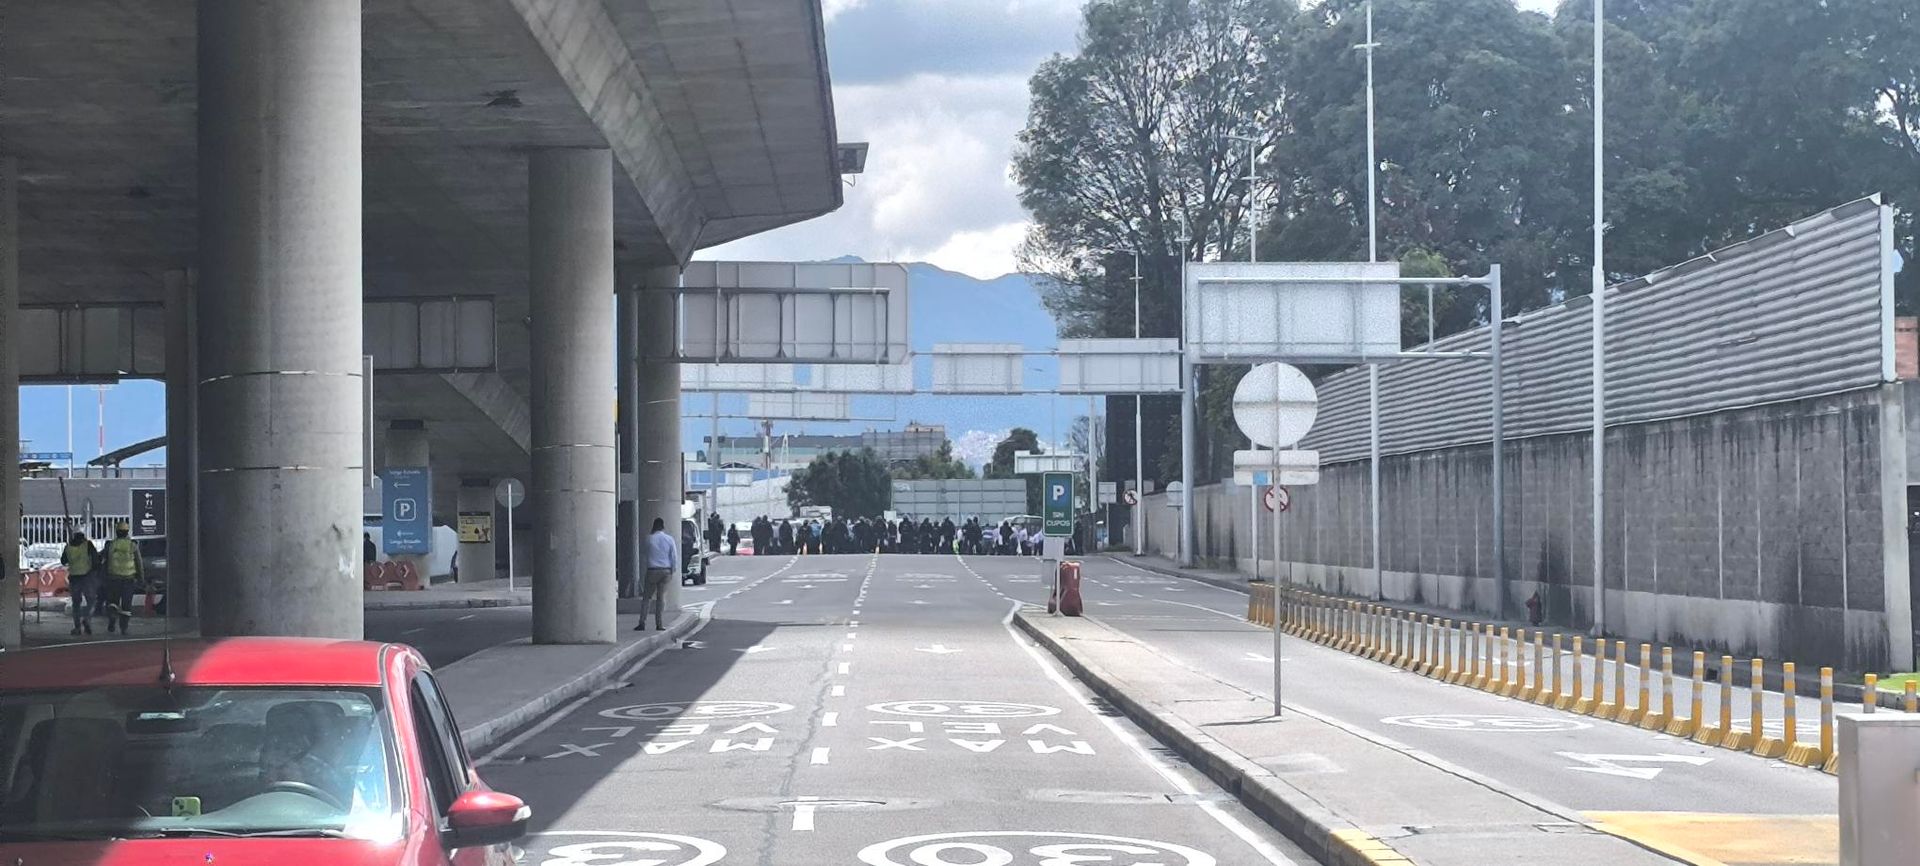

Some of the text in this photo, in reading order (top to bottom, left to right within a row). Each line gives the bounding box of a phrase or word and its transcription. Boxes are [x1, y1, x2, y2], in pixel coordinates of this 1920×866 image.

[1052, 484, 1065, 501] P
[400, 502, 411, 517] P
[1046, 519, 1071, 527] CUPOS
[892, 703, 1036, 715] 30
[581, 721, 780, 738] VEL
[868, 720, 1078, 736] VEL
[543, 737, 776, 759] MAX
[865, 736, 1096, 755] MAX
